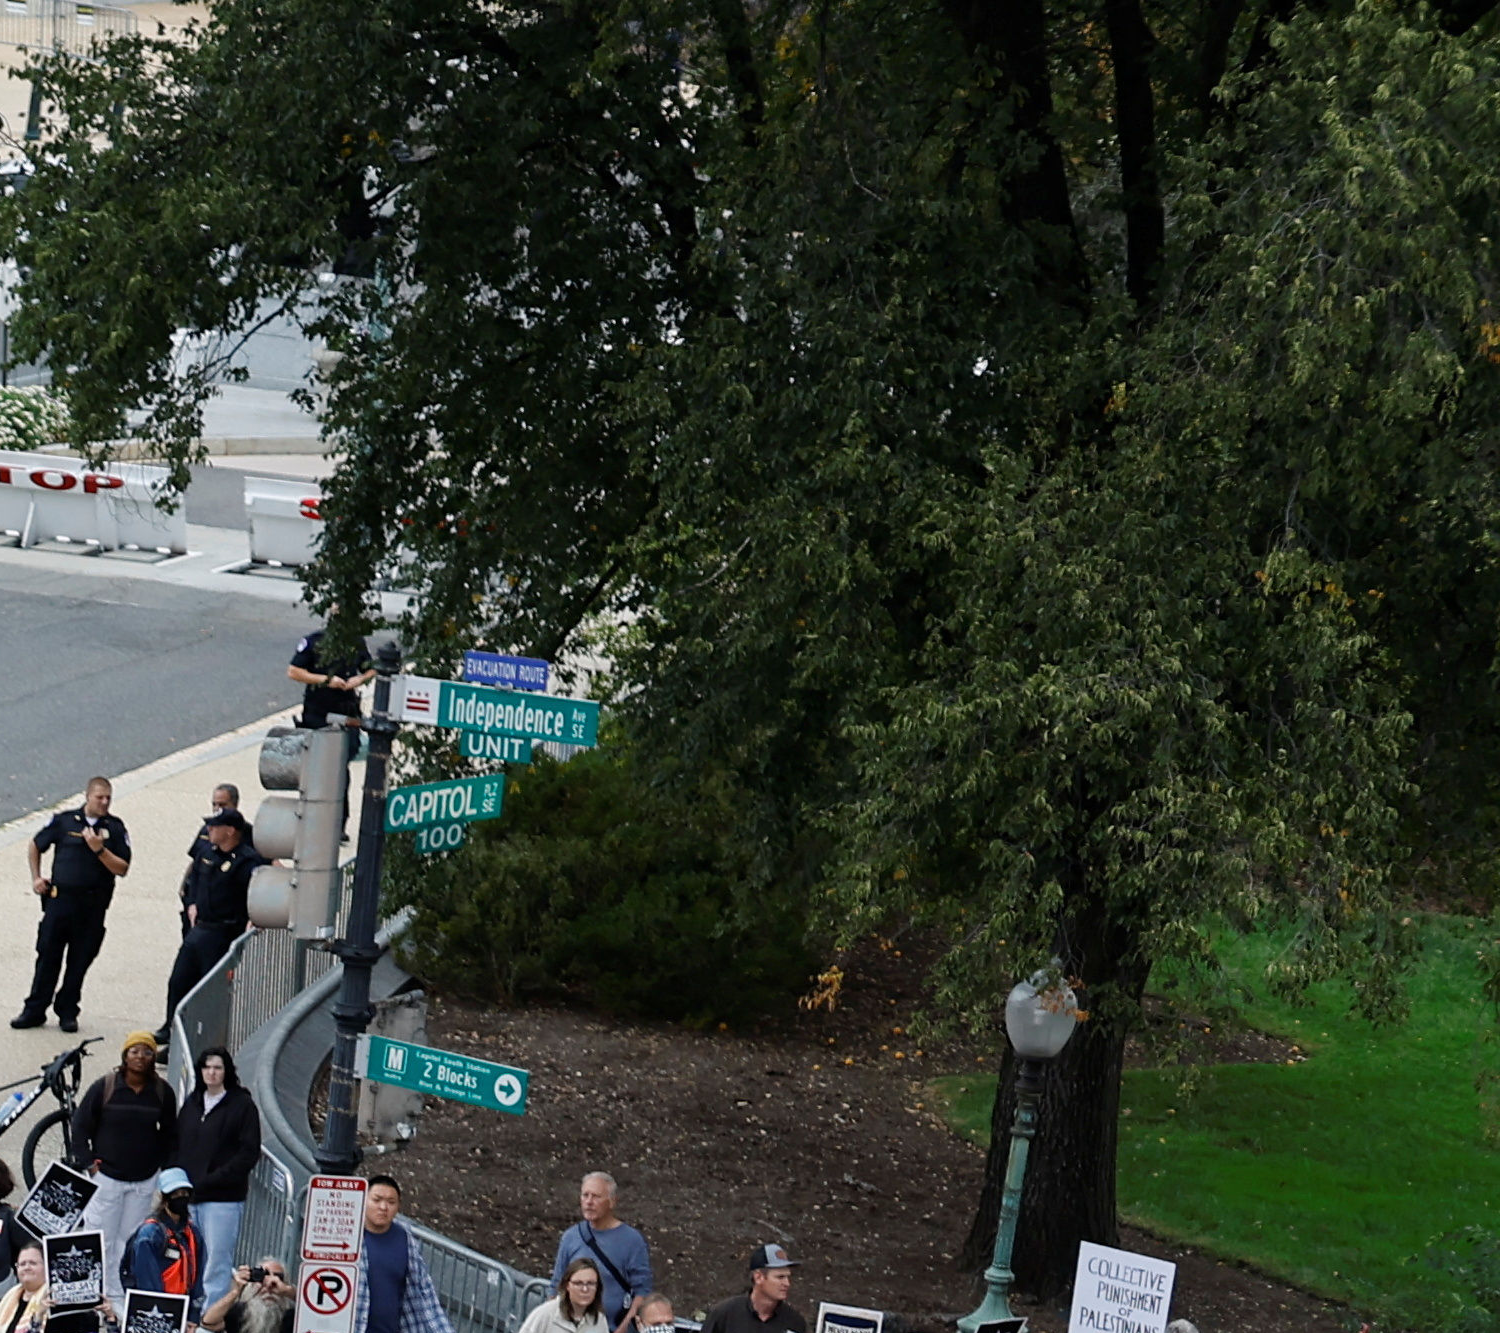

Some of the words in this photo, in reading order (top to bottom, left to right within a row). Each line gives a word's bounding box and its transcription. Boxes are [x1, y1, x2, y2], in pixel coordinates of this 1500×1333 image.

[467, 659, 515, 680] EVACUATION
[519, 666, 545, 683] ROUTE
[450, 689, 564, 737] Independence
[572, 708, 586, 722] Ave
[572, 724, 584, 738] SE
[468, 734, 524, 758] UNIT
[389, 785, 477, 827] CAPITOL
[419, 824, 462, 850] 100
[424, 1062, 432, 1078] 2
[439, 1066, 477, 1089] Blocks
[1087, 1256, 1167, 1294] COLLECTIVE
[1097, 1281, 1163, 1315] PUNISHMENT
[1118, 1307, 1133, 1318] OF
